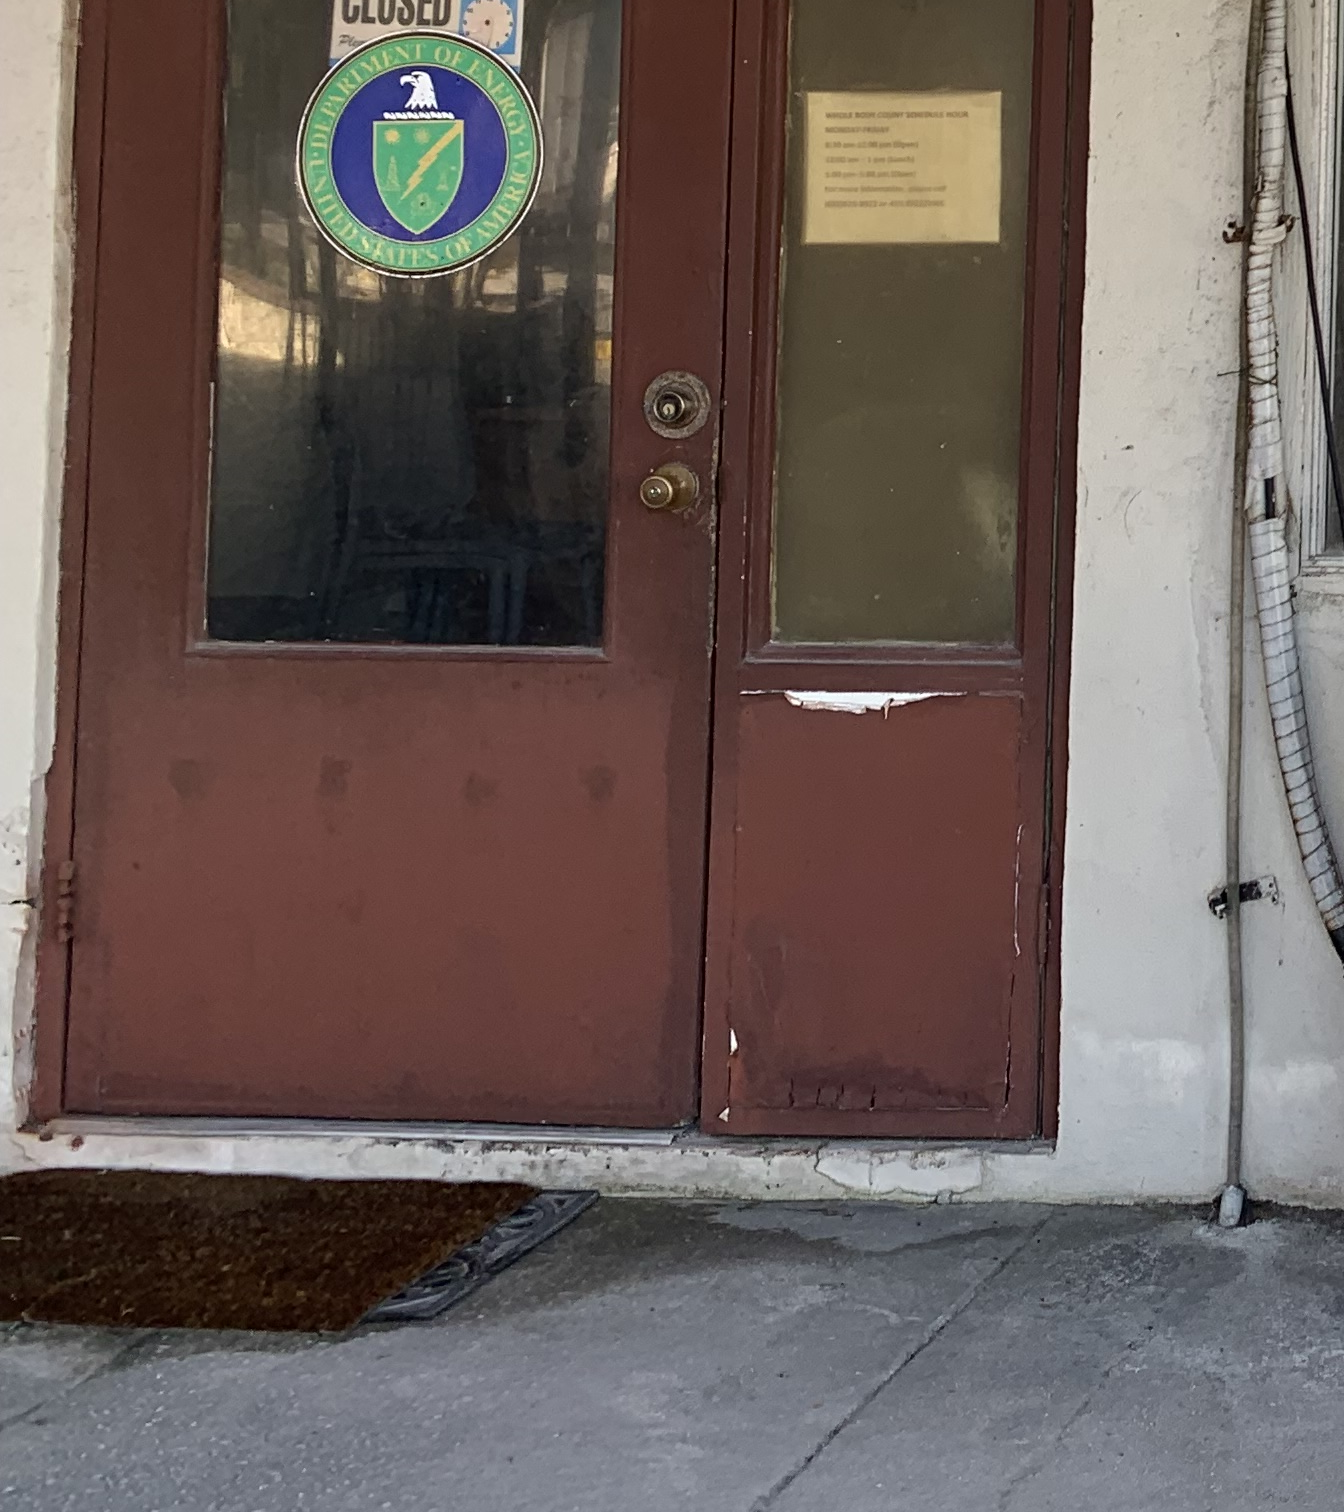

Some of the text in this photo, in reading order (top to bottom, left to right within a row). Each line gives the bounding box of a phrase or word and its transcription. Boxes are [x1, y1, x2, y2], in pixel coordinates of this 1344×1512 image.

[310, 42, 526, 149] DEPARTMENT OF ENERGY
[310, 150, 532, 266] UNITED STATES OF AMERICA
